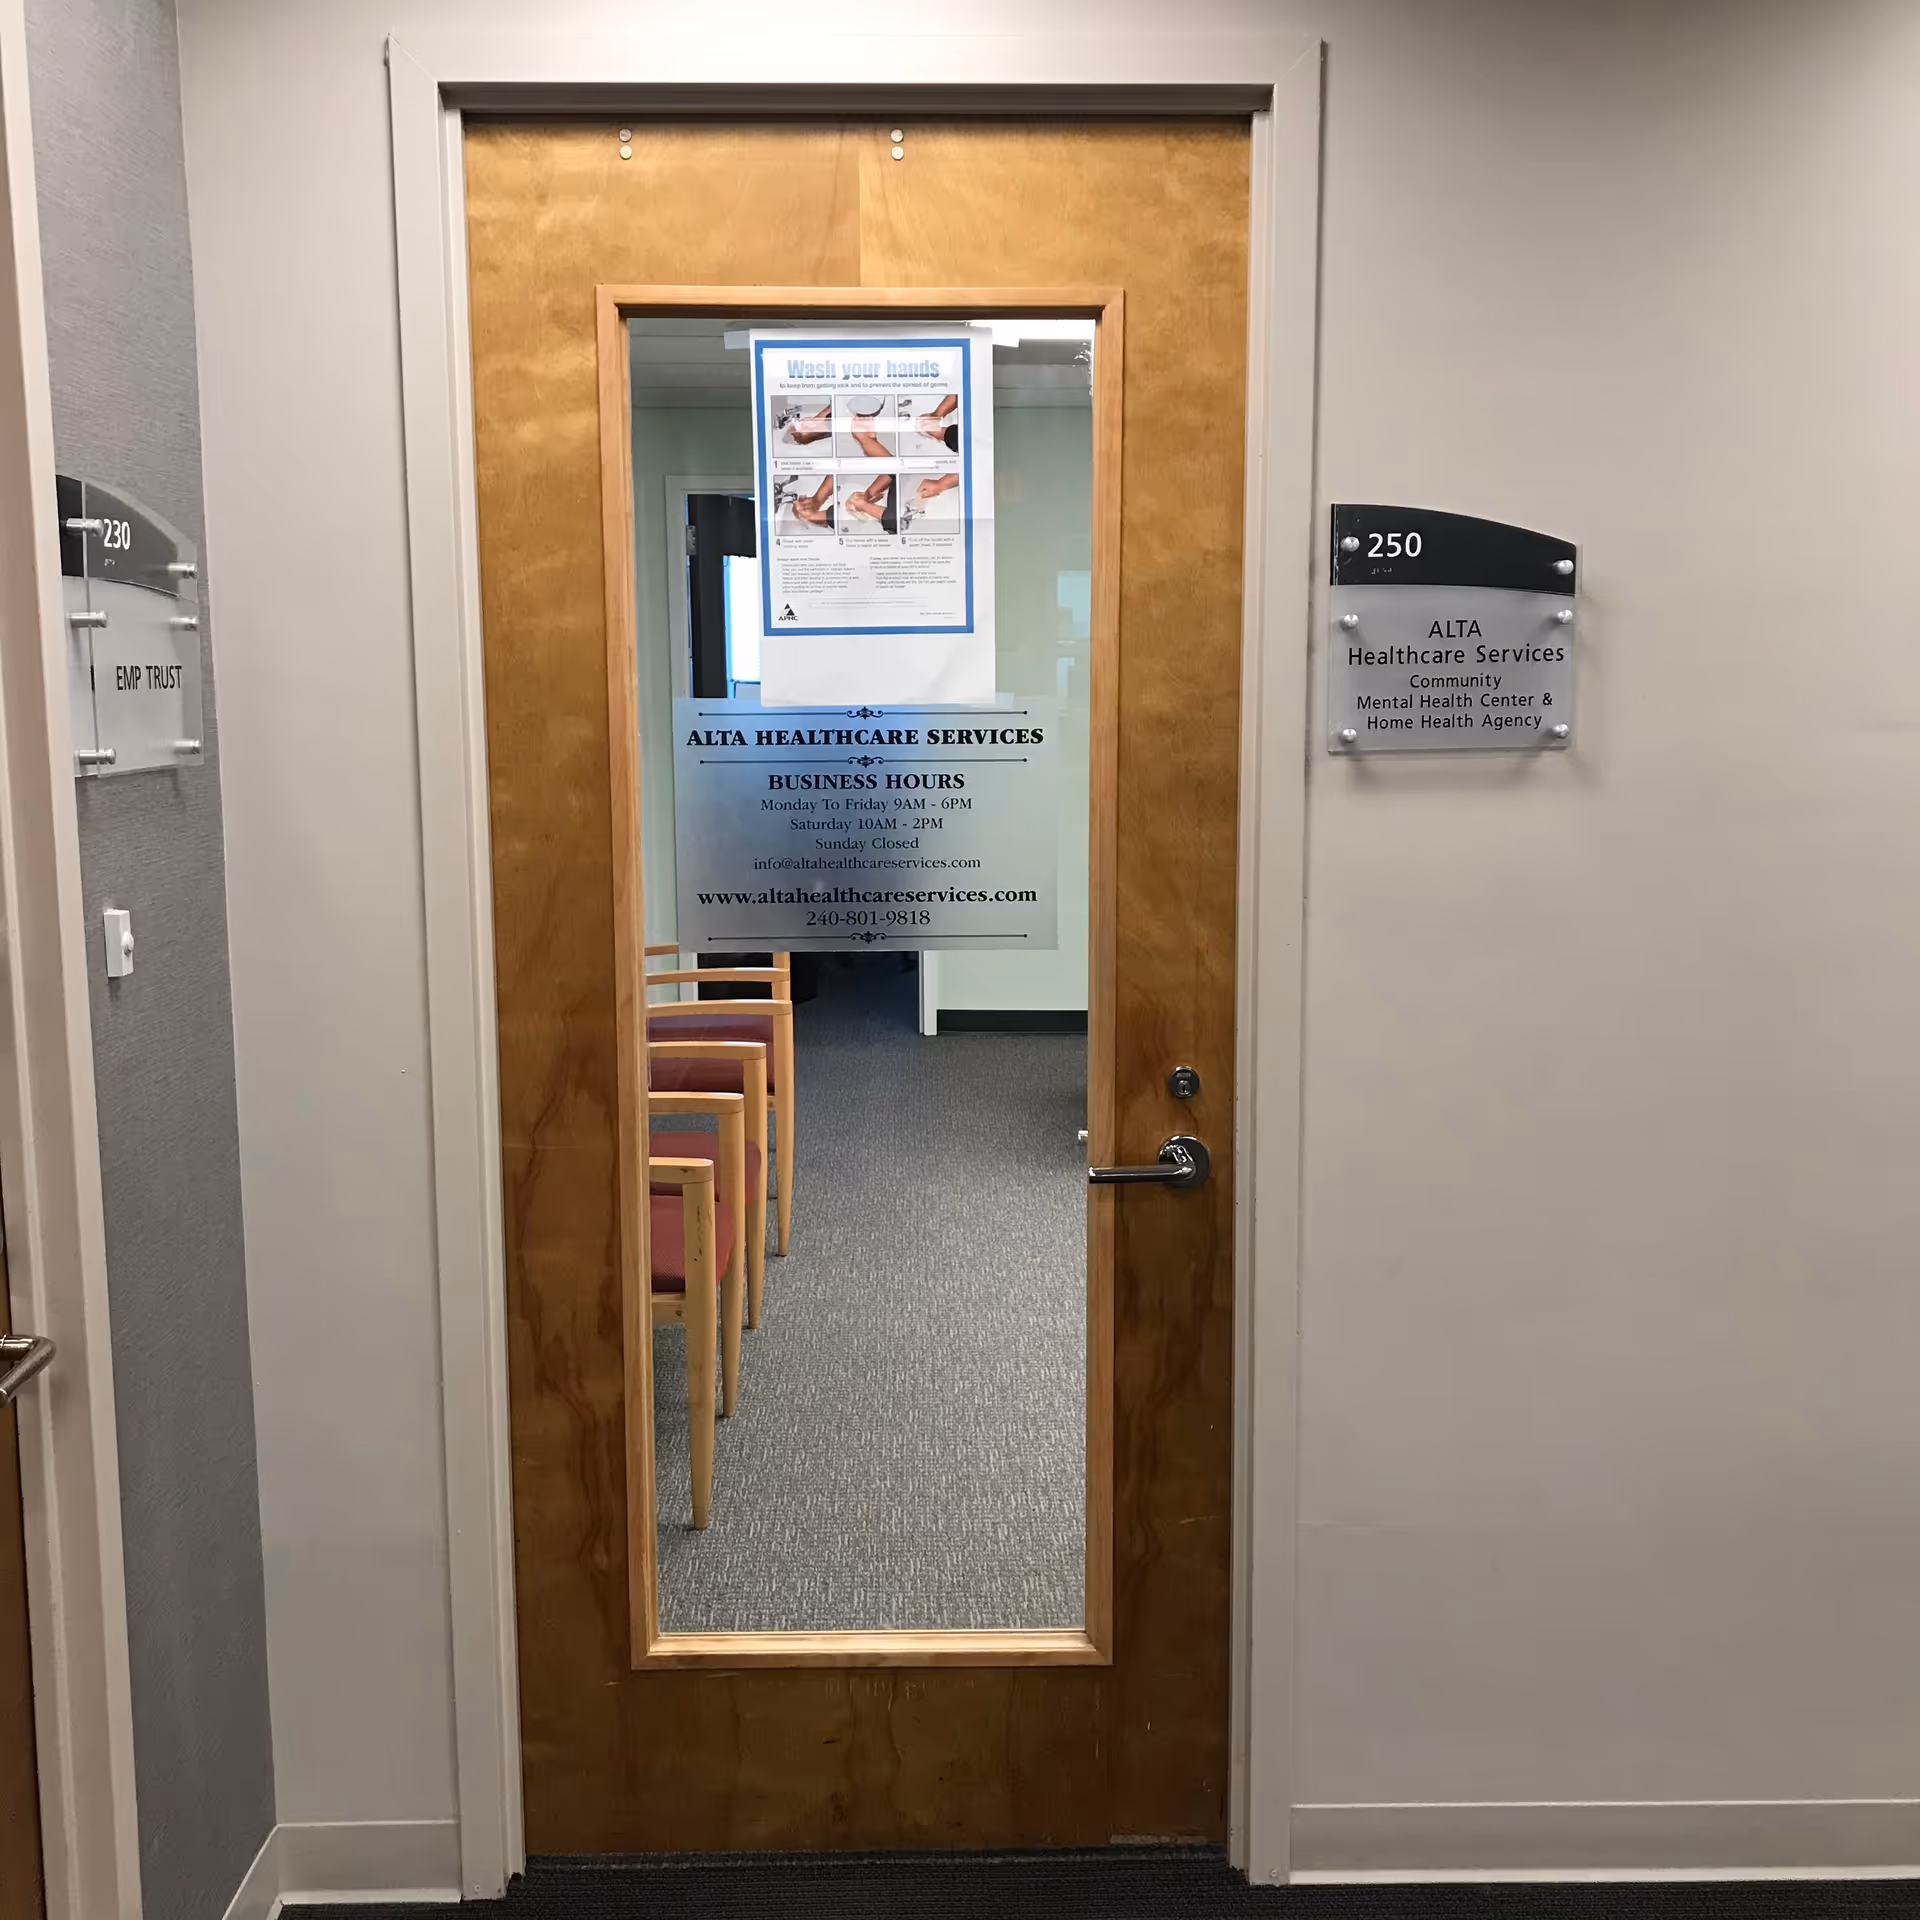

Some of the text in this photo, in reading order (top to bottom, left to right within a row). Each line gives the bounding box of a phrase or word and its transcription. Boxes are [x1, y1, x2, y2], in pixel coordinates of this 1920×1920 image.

[787, 360, 940, 380] Wash your hands
[104, 518, 131, 550] 230
[776, 538, 780, 546] 4
[901, 537, 906, 545] 6
[1367, 532, 1422, 558] 250
[1428, 620, 1482, 638] ALTA
[1349, 643, 1564, 665] Healthcare Services
[116, 665, 182, 690] EMP TRUST
[1410, 672, 1502, 690] Community
[1357, 692, 1553, 709] Mental Health Center &
[1368, 713, 1542, 730] Home Health Agency
[686, 728, 1044, 746] ALTA HEALTHCARE SERVICES
[768, 773, 965, 791] BUSINESS HOURS
[761, 798, 818, 813] Monday
[822, 798, 840, 811] To
[845, 798, 889, 813] Friday
[894, 797, 926, 811] 9AM
[941, 797, 972, 810] 6PM
[790, 818, 852, 832] Saturday
[858, 817, 898, 830] 10AM
[912, 817, 944, 830] 2PM
[815, 837, 920, 852] Sunday Closed
[753, 856, 981, 871] info@altahealthcareservices.com
[696, 886, 1038, 905] www.altahealthcareservices.com
[806, 909, 931, 927] 240-801-9818
